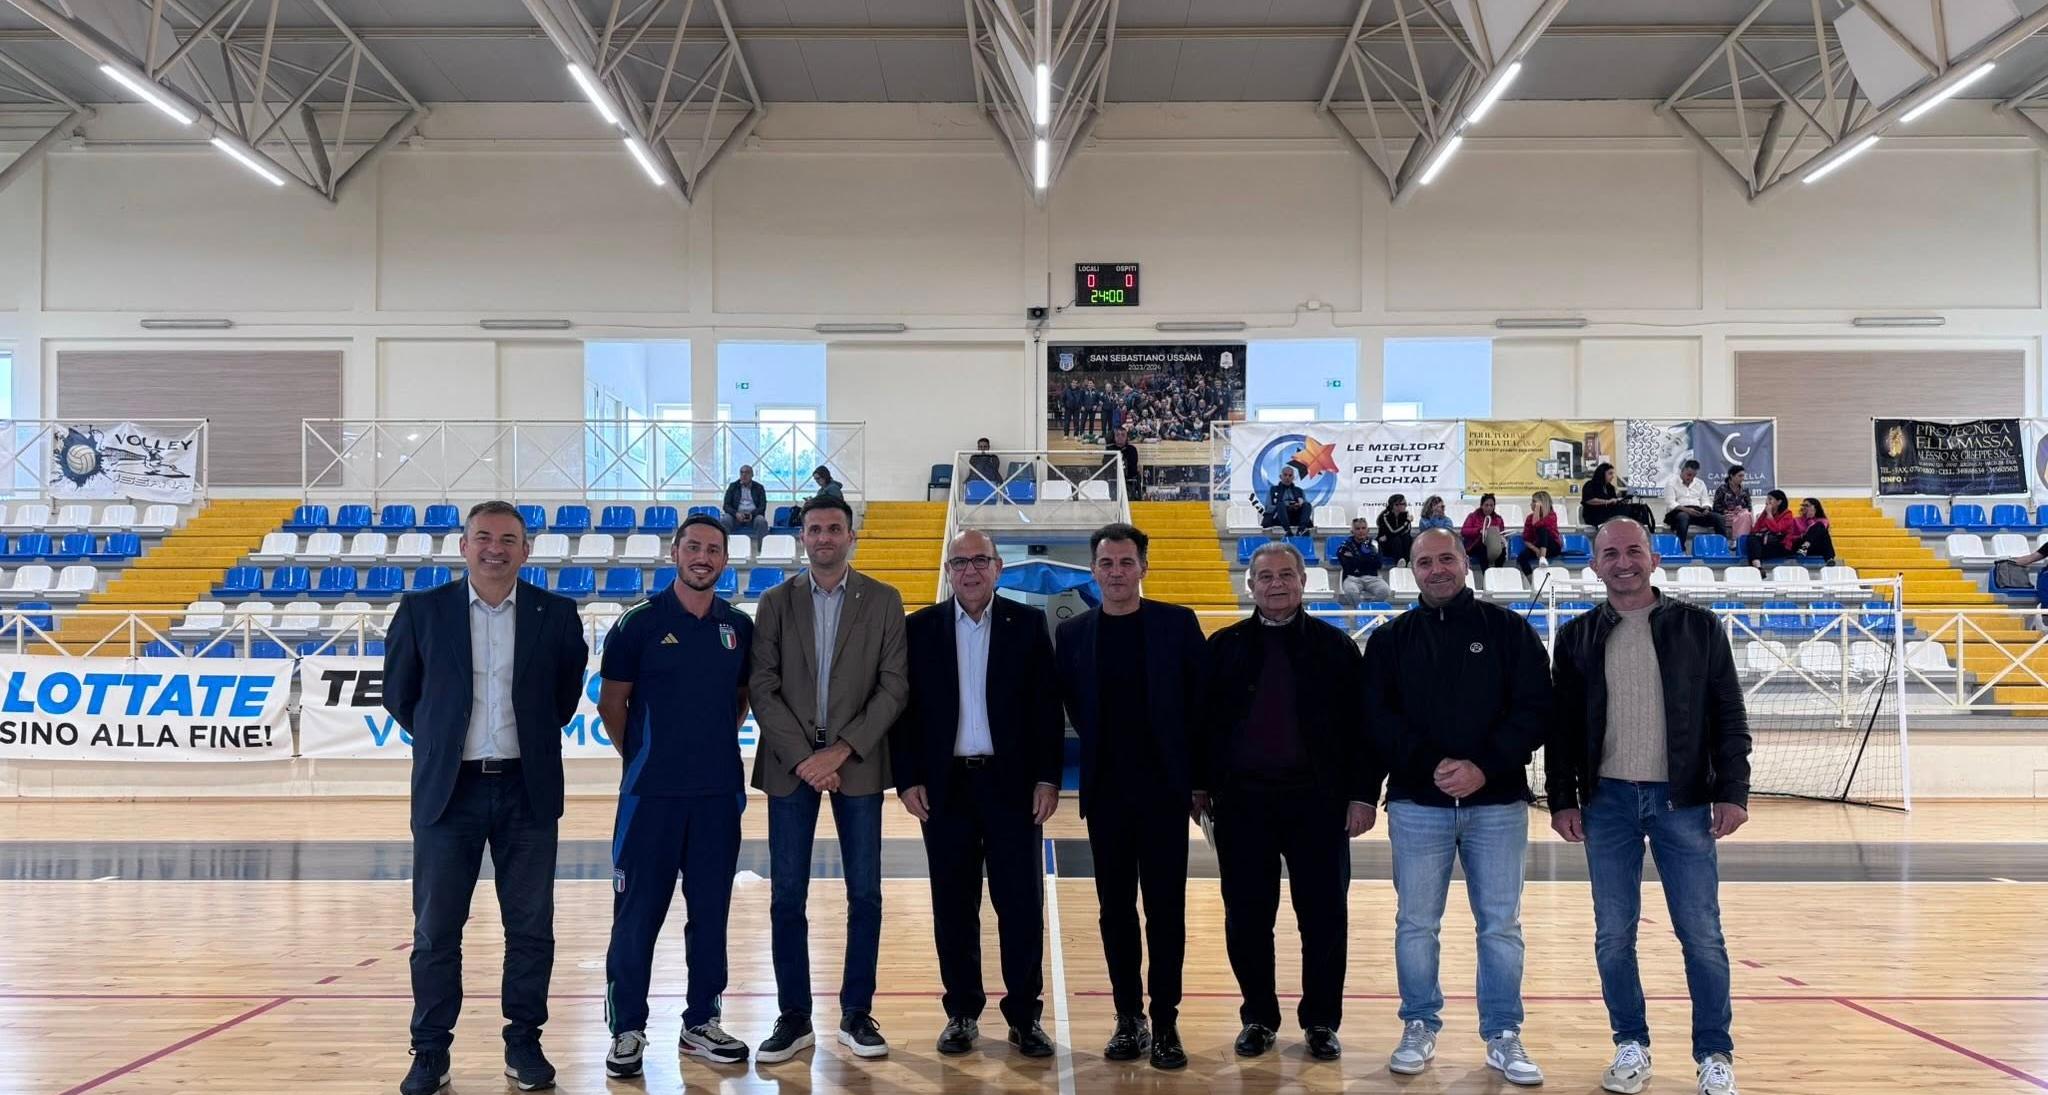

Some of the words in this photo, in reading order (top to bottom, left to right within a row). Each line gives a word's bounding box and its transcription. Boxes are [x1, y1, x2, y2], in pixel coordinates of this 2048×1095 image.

[1087, 274, 1095, 287] 0
[1125, 274, 1133, 287] 0
[1091, 289, 1124, 303] 24:00
[1090, 354, 1108, 362] SAN
[1110, 354, 1165, 362] SEBASTIANO
[1167, 353, 1203, 362] USSANA
[1916, 423, 2010, 437] PIROTECNICA
[114, 433, 193, 451] VOLLEY
[1347, 443, 1365, 452] LE
[1368, 442, 1446, 452] MIGLIORI
[1957, 435, 2014, 449] MASSA
[1376, 453, 1422, 462] LENTI
[1353, 465, 1384, 474] PER
[1388, 465, 1396, 473] I
[1400, 465, 1439, 473] TUOI
[1708, 472, 1766, 480] CAMELLA
[1359, 475, 1438, 484] OCCHIALI
[1, 671, 275, 717] LOTTATE
[0, 720, 79, 746] SINO
[90, 722, 180, 748] ALLA
[189, 725, 273, 748] FINE!
